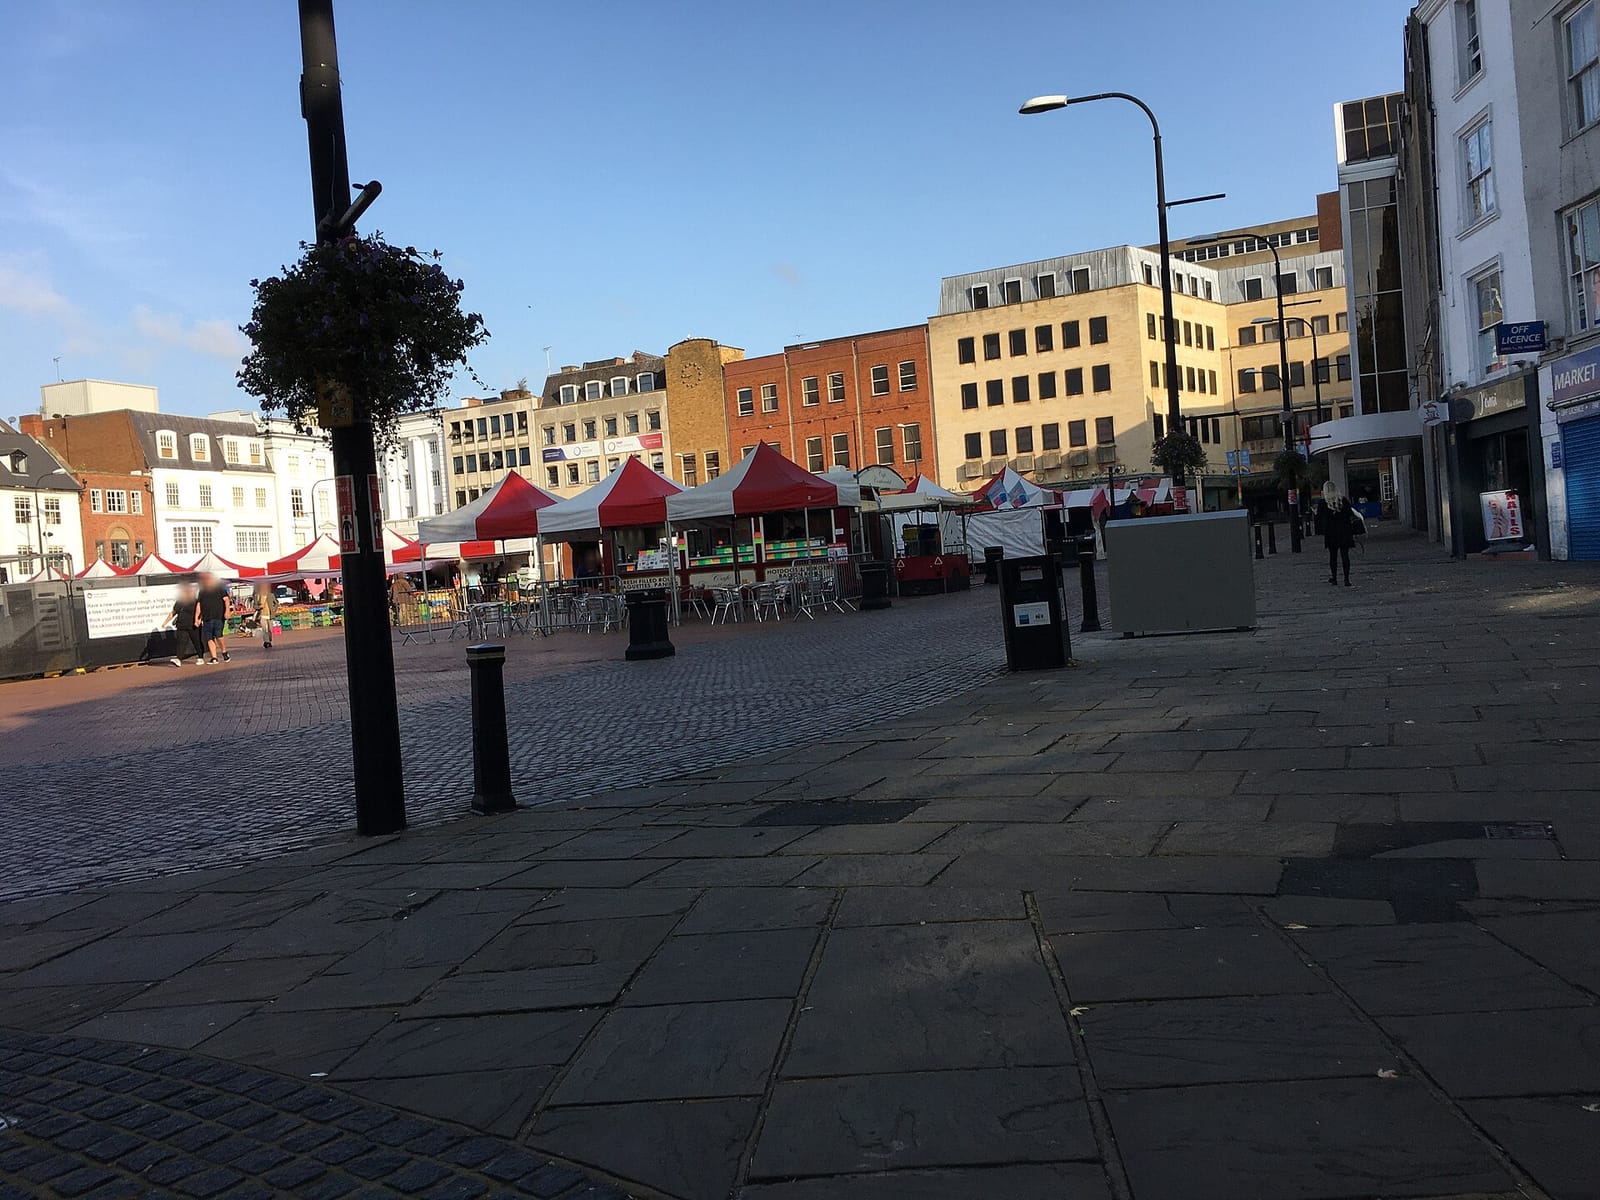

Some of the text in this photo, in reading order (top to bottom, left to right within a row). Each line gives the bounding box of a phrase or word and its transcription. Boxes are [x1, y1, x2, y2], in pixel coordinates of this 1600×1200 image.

[1511, 325, 1529, 334] OFF
[1501, 334, 1541, 345] LICENCE
[1554, 363, 1597, 391] MARKET
[1505, 492, 1520, 535] NAILS
